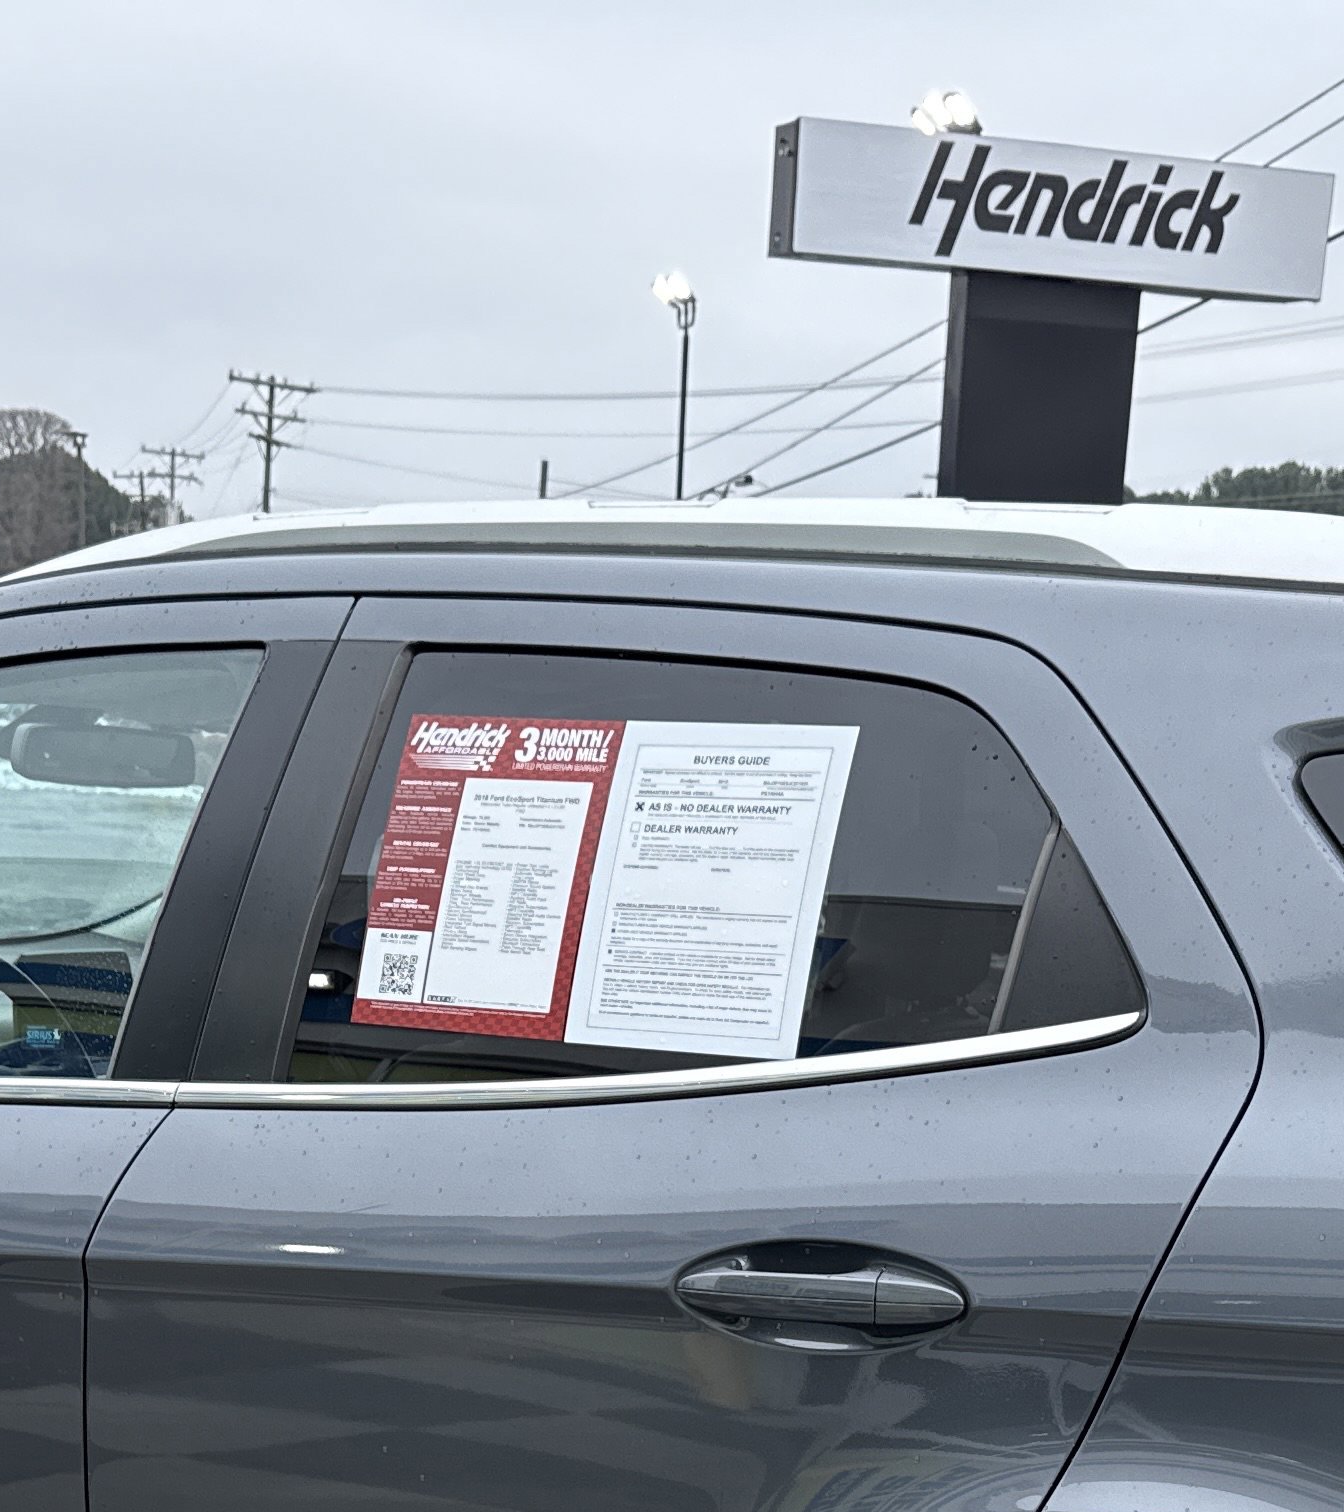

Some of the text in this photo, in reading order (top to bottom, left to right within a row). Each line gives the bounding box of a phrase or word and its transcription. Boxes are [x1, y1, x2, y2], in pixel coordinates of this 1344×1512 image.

[908, 141, 1240, 256] Hendrick
[411, 721, 511, 753] Hendrick
[423, 747, 501, 755] AFFORDABLE
[514, 727, 614, 762] 3 MONTH/
[537, 745, 608, 763] 3,000 MILE
[693, 755, 771, 766] BUYERS GUIDE
[506, 795, 535, 804] EcoSport
[536, 796, 564, 804] Titanium
[648, 802, 661, 811] AS
[663, 803, 673, 812] IS
[680, 804, 694, 812] NO
[696, 804, 734, 813] DEALER
[736, 805, 792, 815] WARRANTY
[644, 824, 739, 836] DEALER WARRANTY
